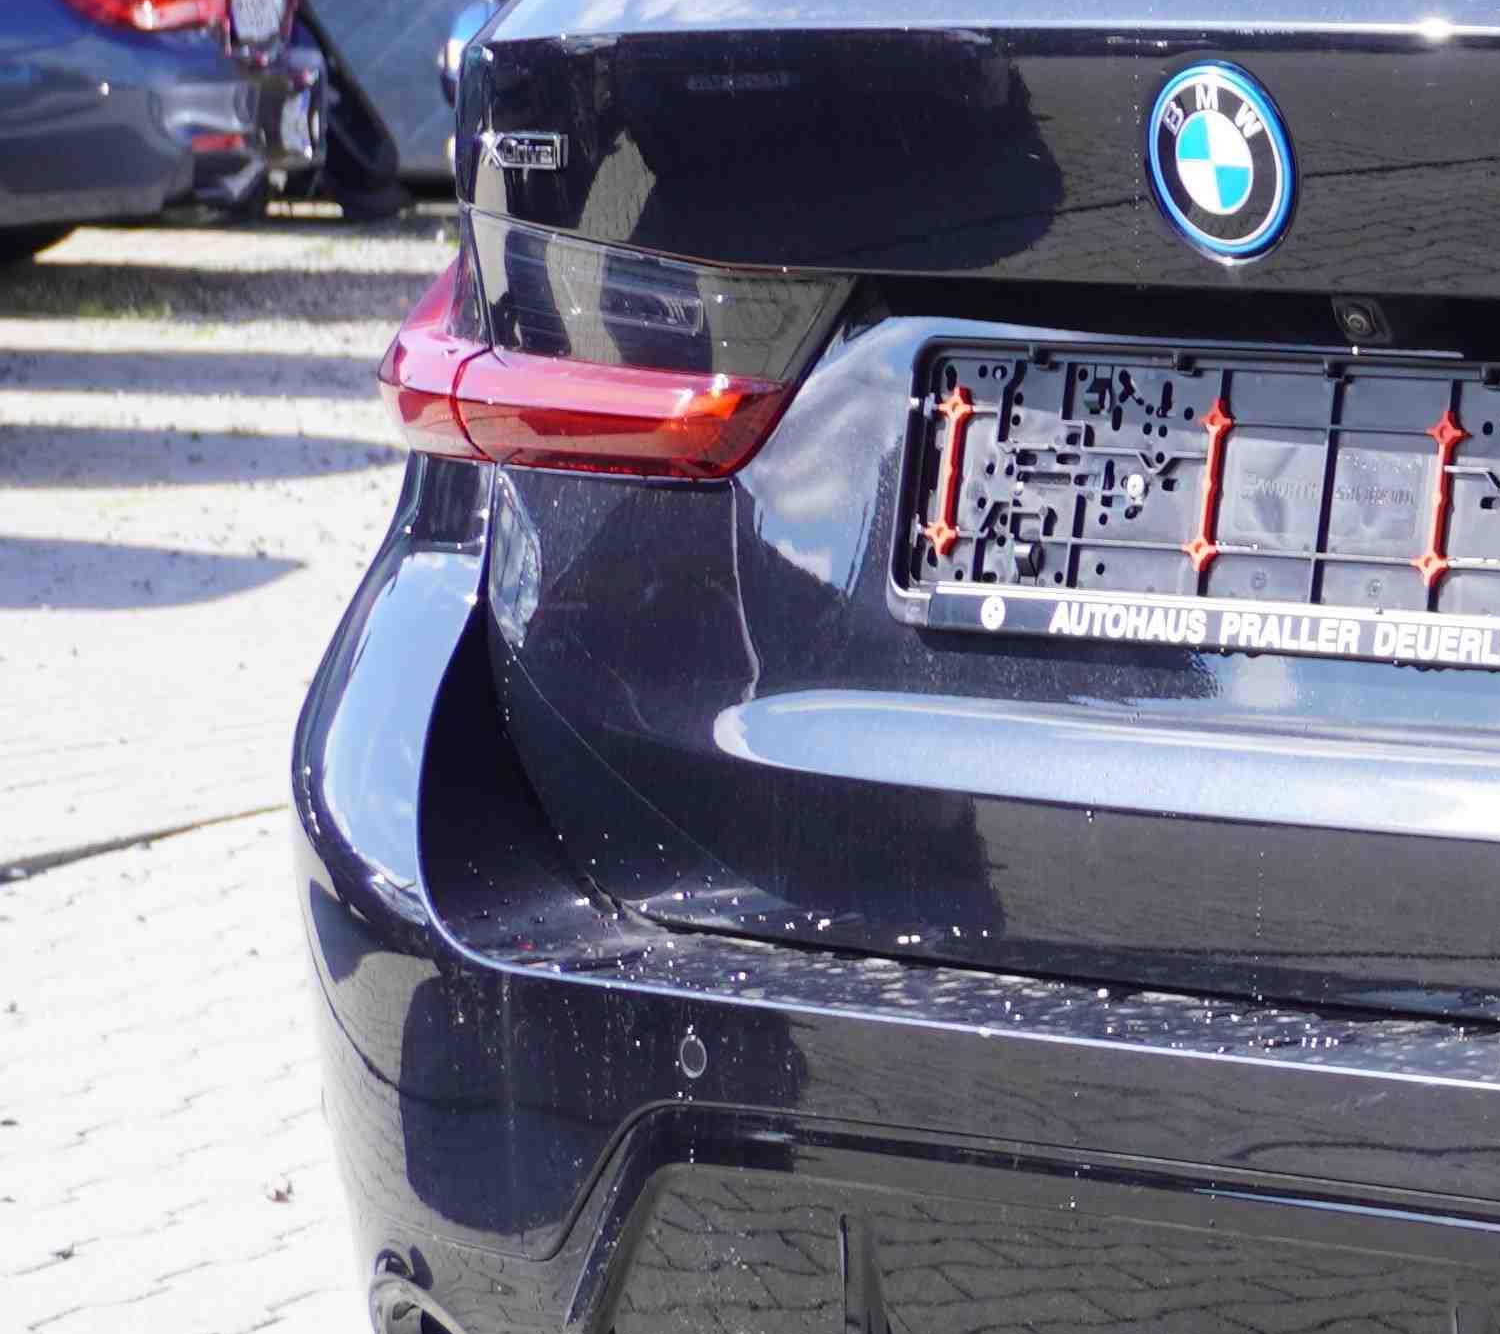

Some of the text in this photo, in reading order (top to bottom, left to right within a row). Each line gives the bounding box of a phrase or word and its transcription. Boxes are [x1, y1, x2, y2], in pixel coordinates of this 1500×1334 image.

[1161, 81, 1263, 138] BMW
[1048, 601, 1206, 644] AUTOHAUS
[1219, 613, 1360, 654] PRALLER
